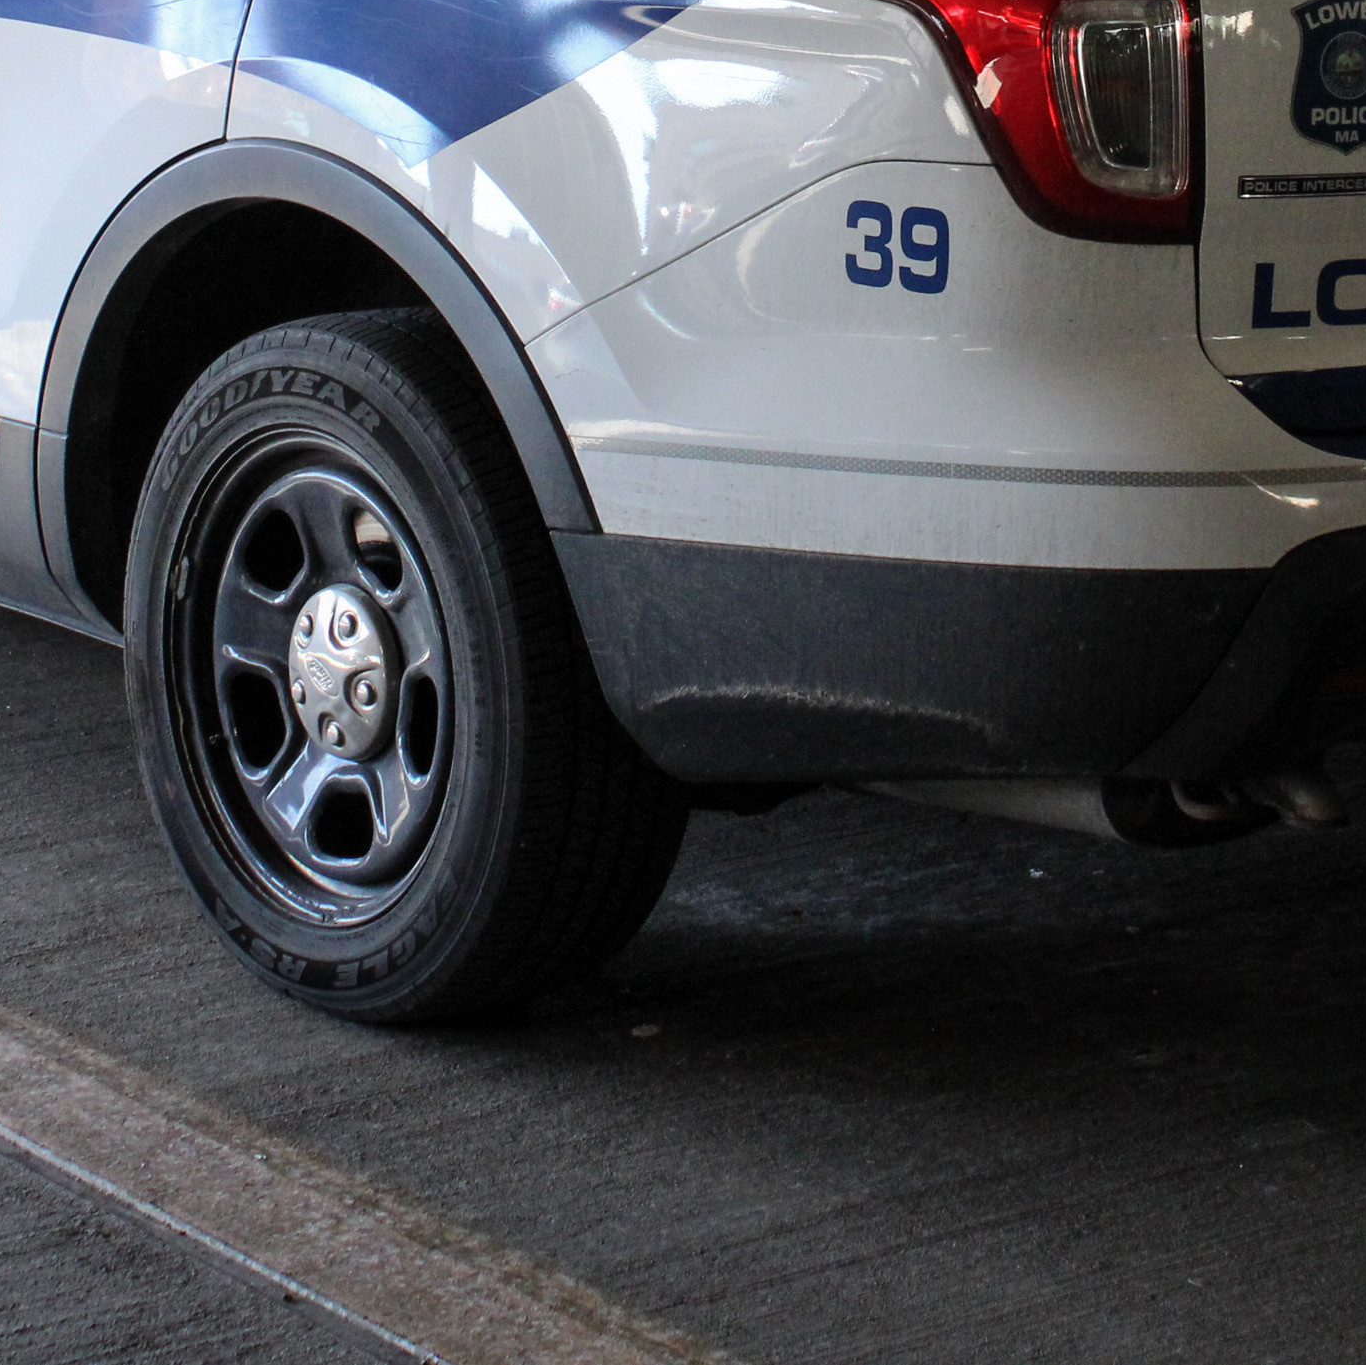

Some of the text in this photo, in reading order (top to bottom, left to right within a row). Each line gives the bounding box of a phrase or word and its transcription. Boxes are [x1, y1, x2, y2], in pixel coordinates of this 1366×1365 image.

[1336, 130, 1360, 143] MA
[1244, 181, 1297, 193] POLICE
[845, 200, 950, 294] 39
[162, 370, 381, 492] GOODYEAR
